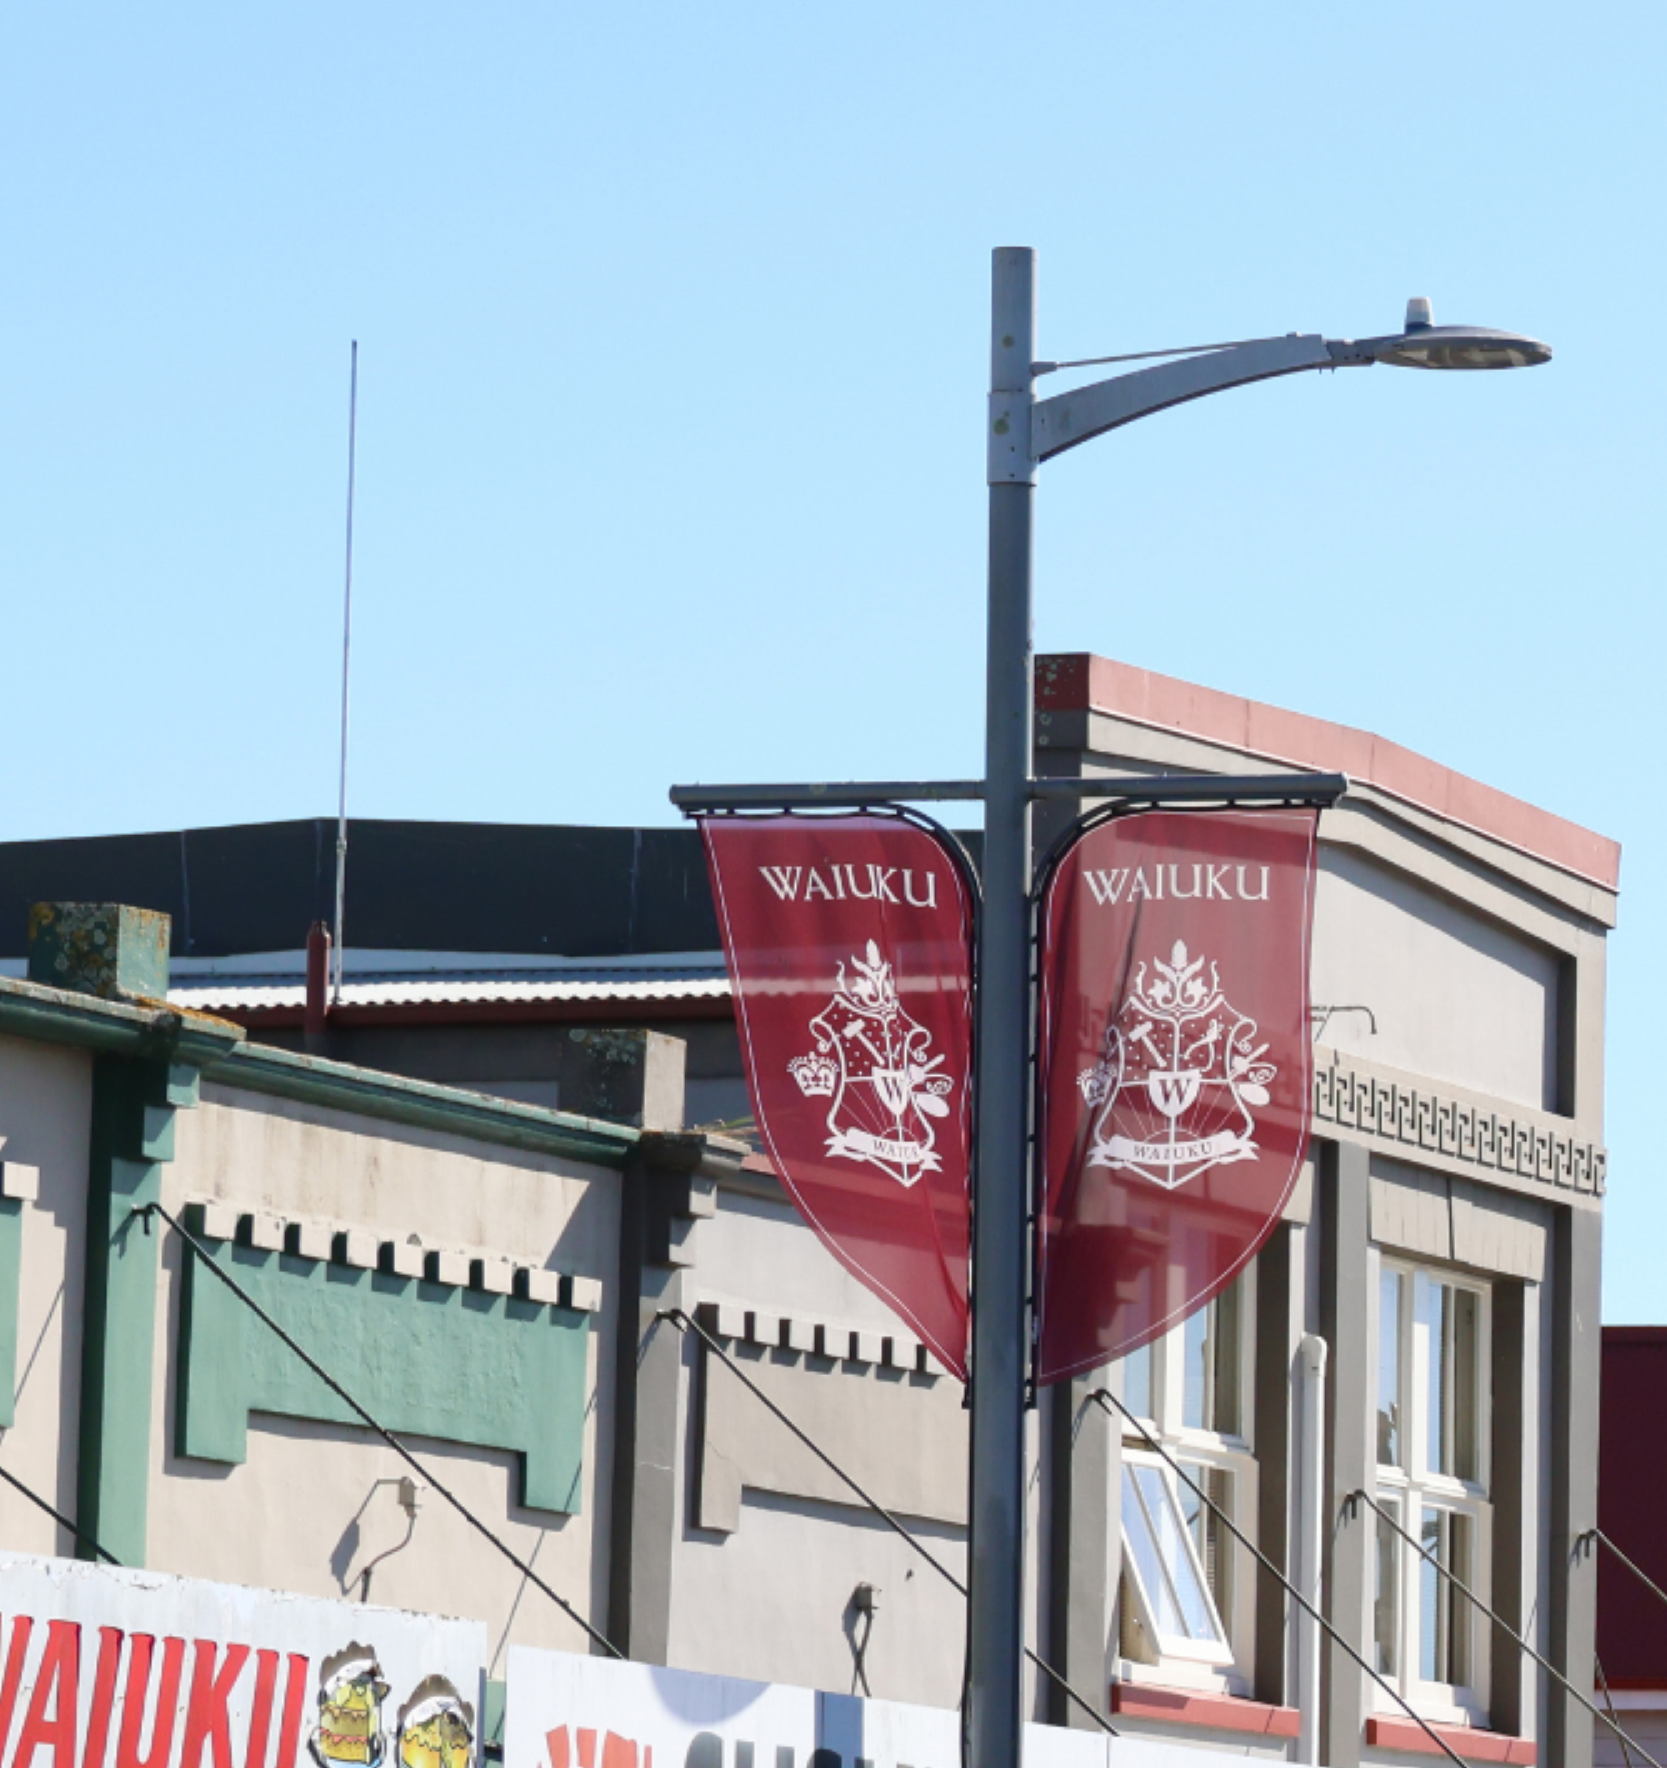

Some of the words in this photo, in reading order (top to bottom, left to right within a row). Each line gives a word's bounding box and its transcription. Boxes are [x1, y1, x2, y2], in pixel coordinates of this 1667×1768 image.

[758, 863, 937, 908] WAIUKU
[1084, 863, 1270, 906] WAIUKU
[1157, 1078, 1192, 1106] W
